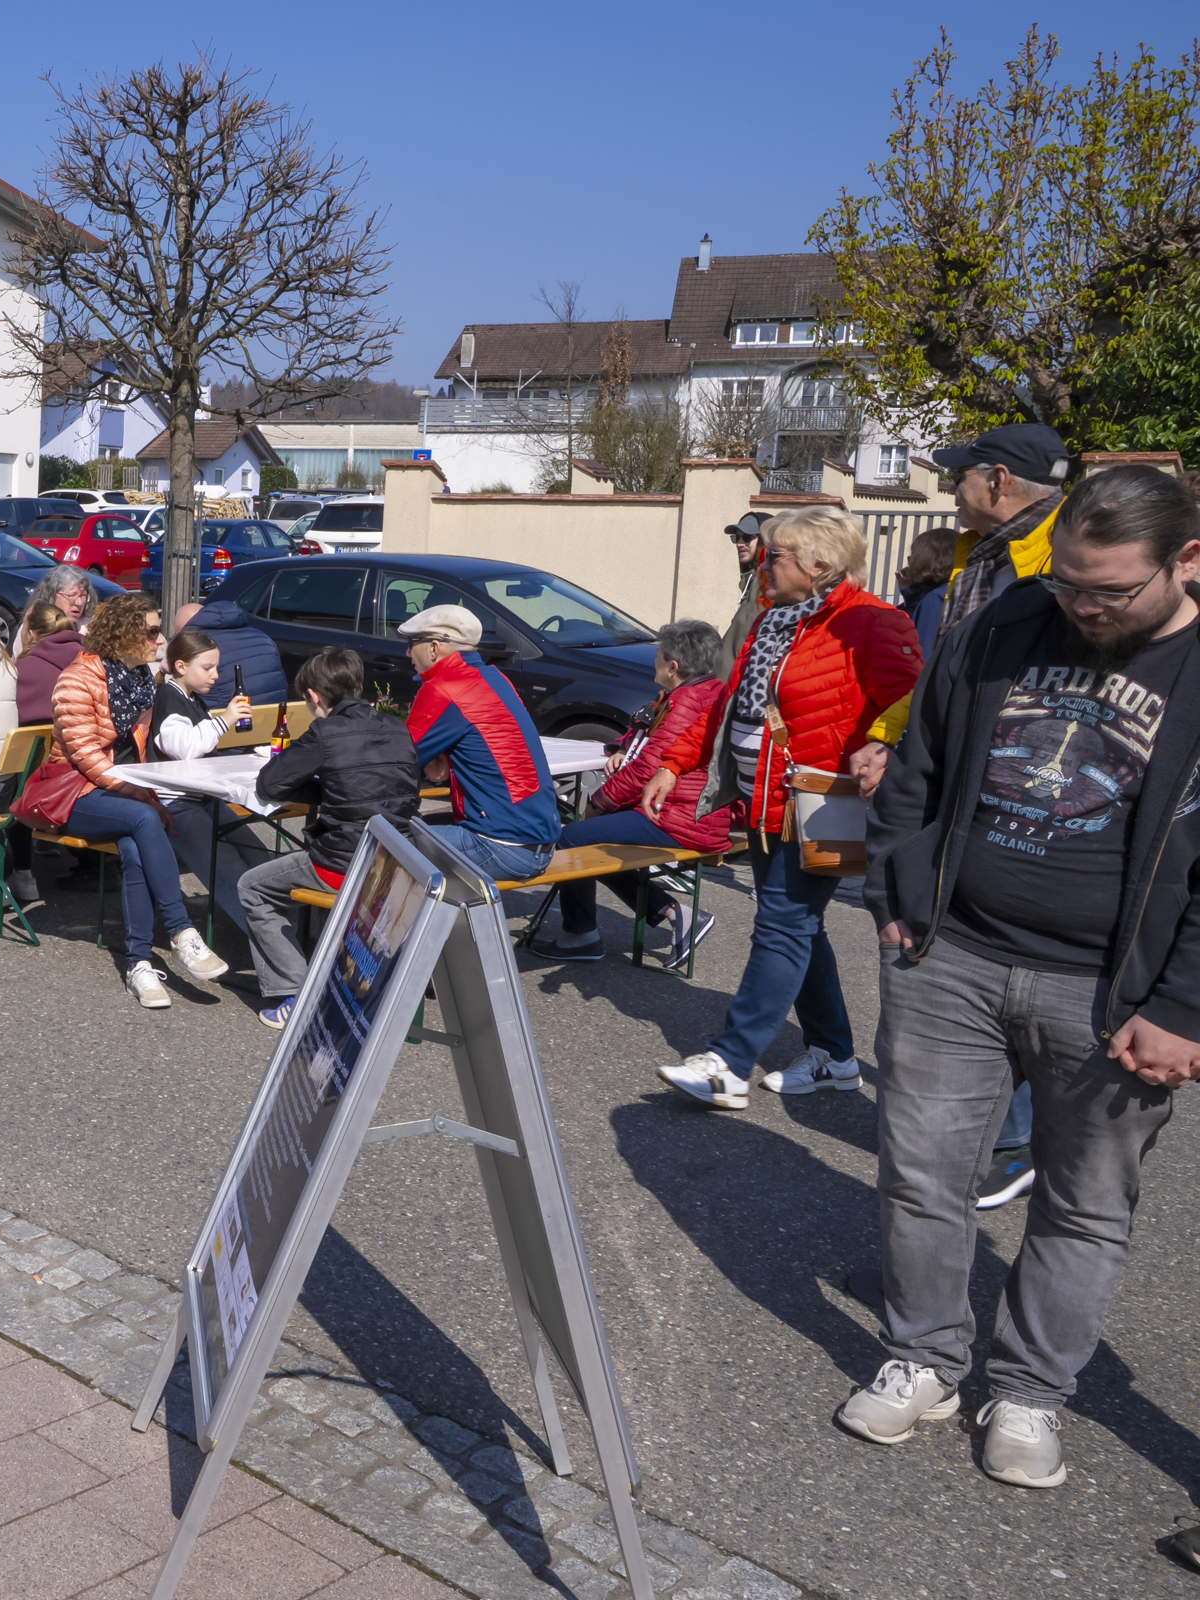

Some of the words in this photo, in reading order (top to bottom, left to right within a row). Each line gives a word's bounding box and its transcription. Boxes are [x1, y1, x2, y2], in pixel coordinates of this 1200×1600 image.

[1010, 666, 1097, 693] ARD
[1096, 673, 1167, 725] ROC
[1042, 695, 1116, 721] WORLD
[1055, 709, 1098, 727] TOUR
[986, 830, 1046, 856] ORLANDO
